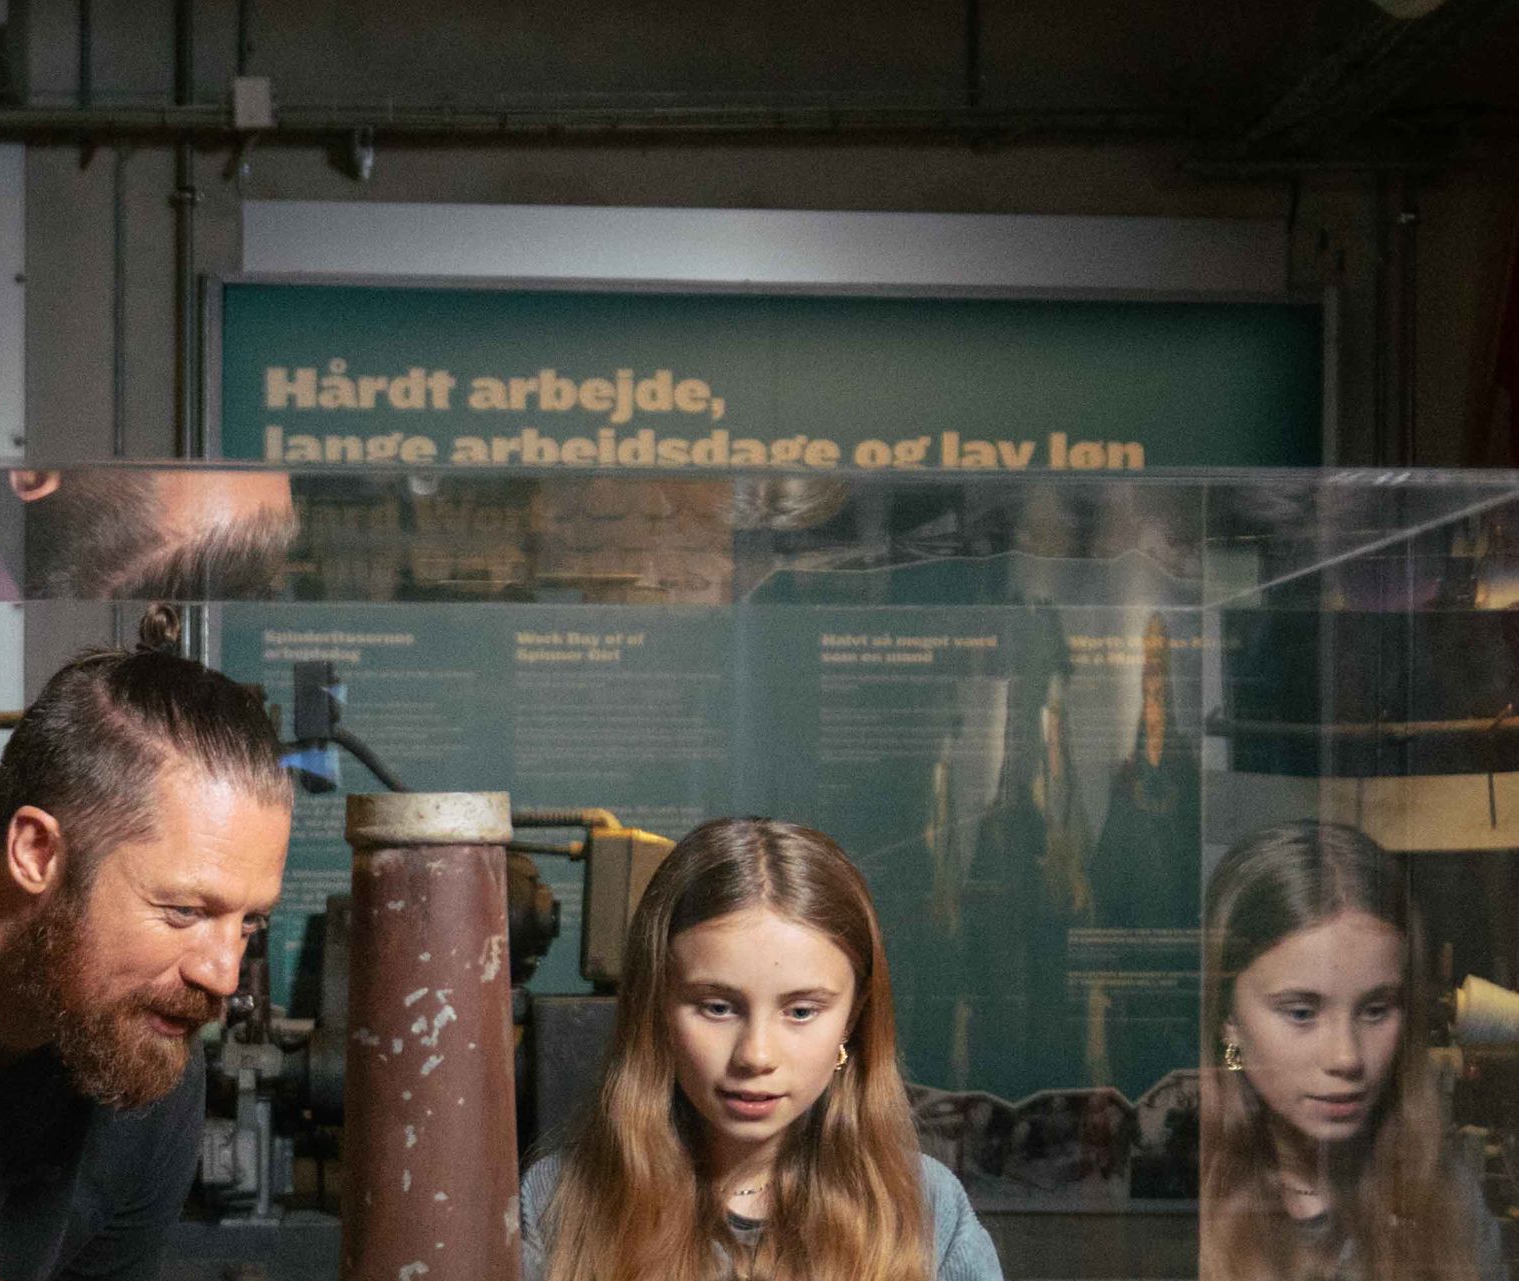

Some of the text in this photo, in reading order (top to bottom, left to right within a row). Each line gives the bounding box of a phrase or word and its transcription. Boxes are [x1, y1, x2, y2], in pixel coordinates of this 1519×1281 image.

[266, 357, 727, 425] Hårdt arbejde,
[265, 426, 439, 466] lange
[941, 431, 1036, 470] lav
[1049, 431, 1145, 470] løn
